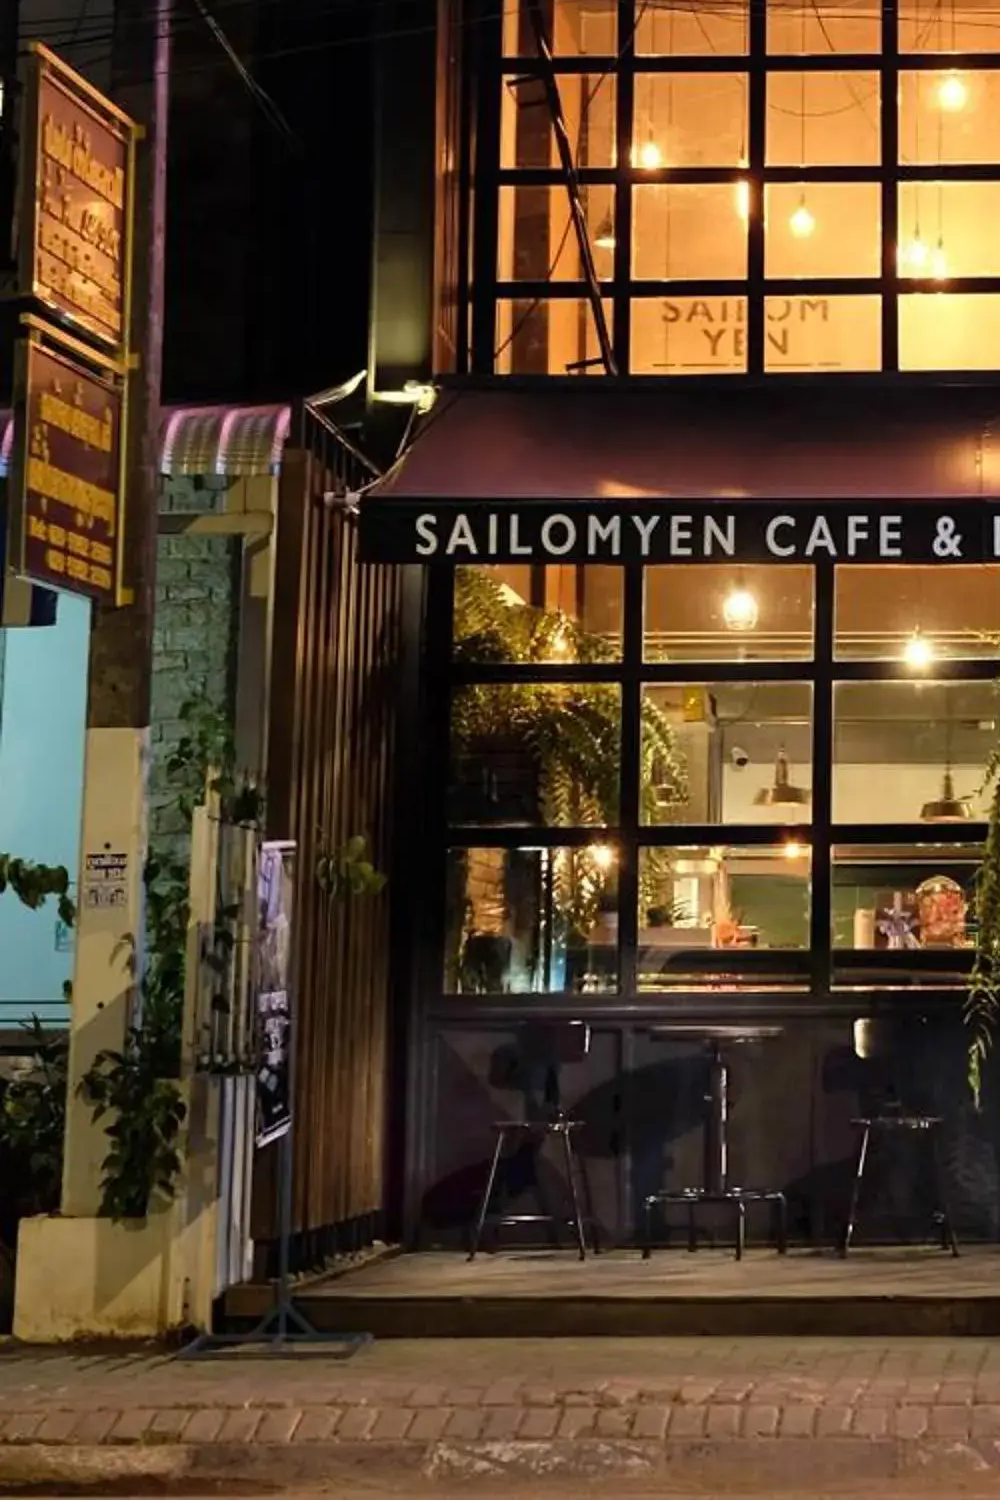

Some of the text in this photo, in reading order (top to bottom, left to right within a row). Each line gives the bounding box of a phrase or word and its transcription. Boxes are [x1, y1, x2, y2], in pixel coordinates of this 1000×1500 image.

[414, 513, 735, 557] SAILOMYEN
[766, 514, 903, 558] CAFE
[932, 514, 963, 558] &
